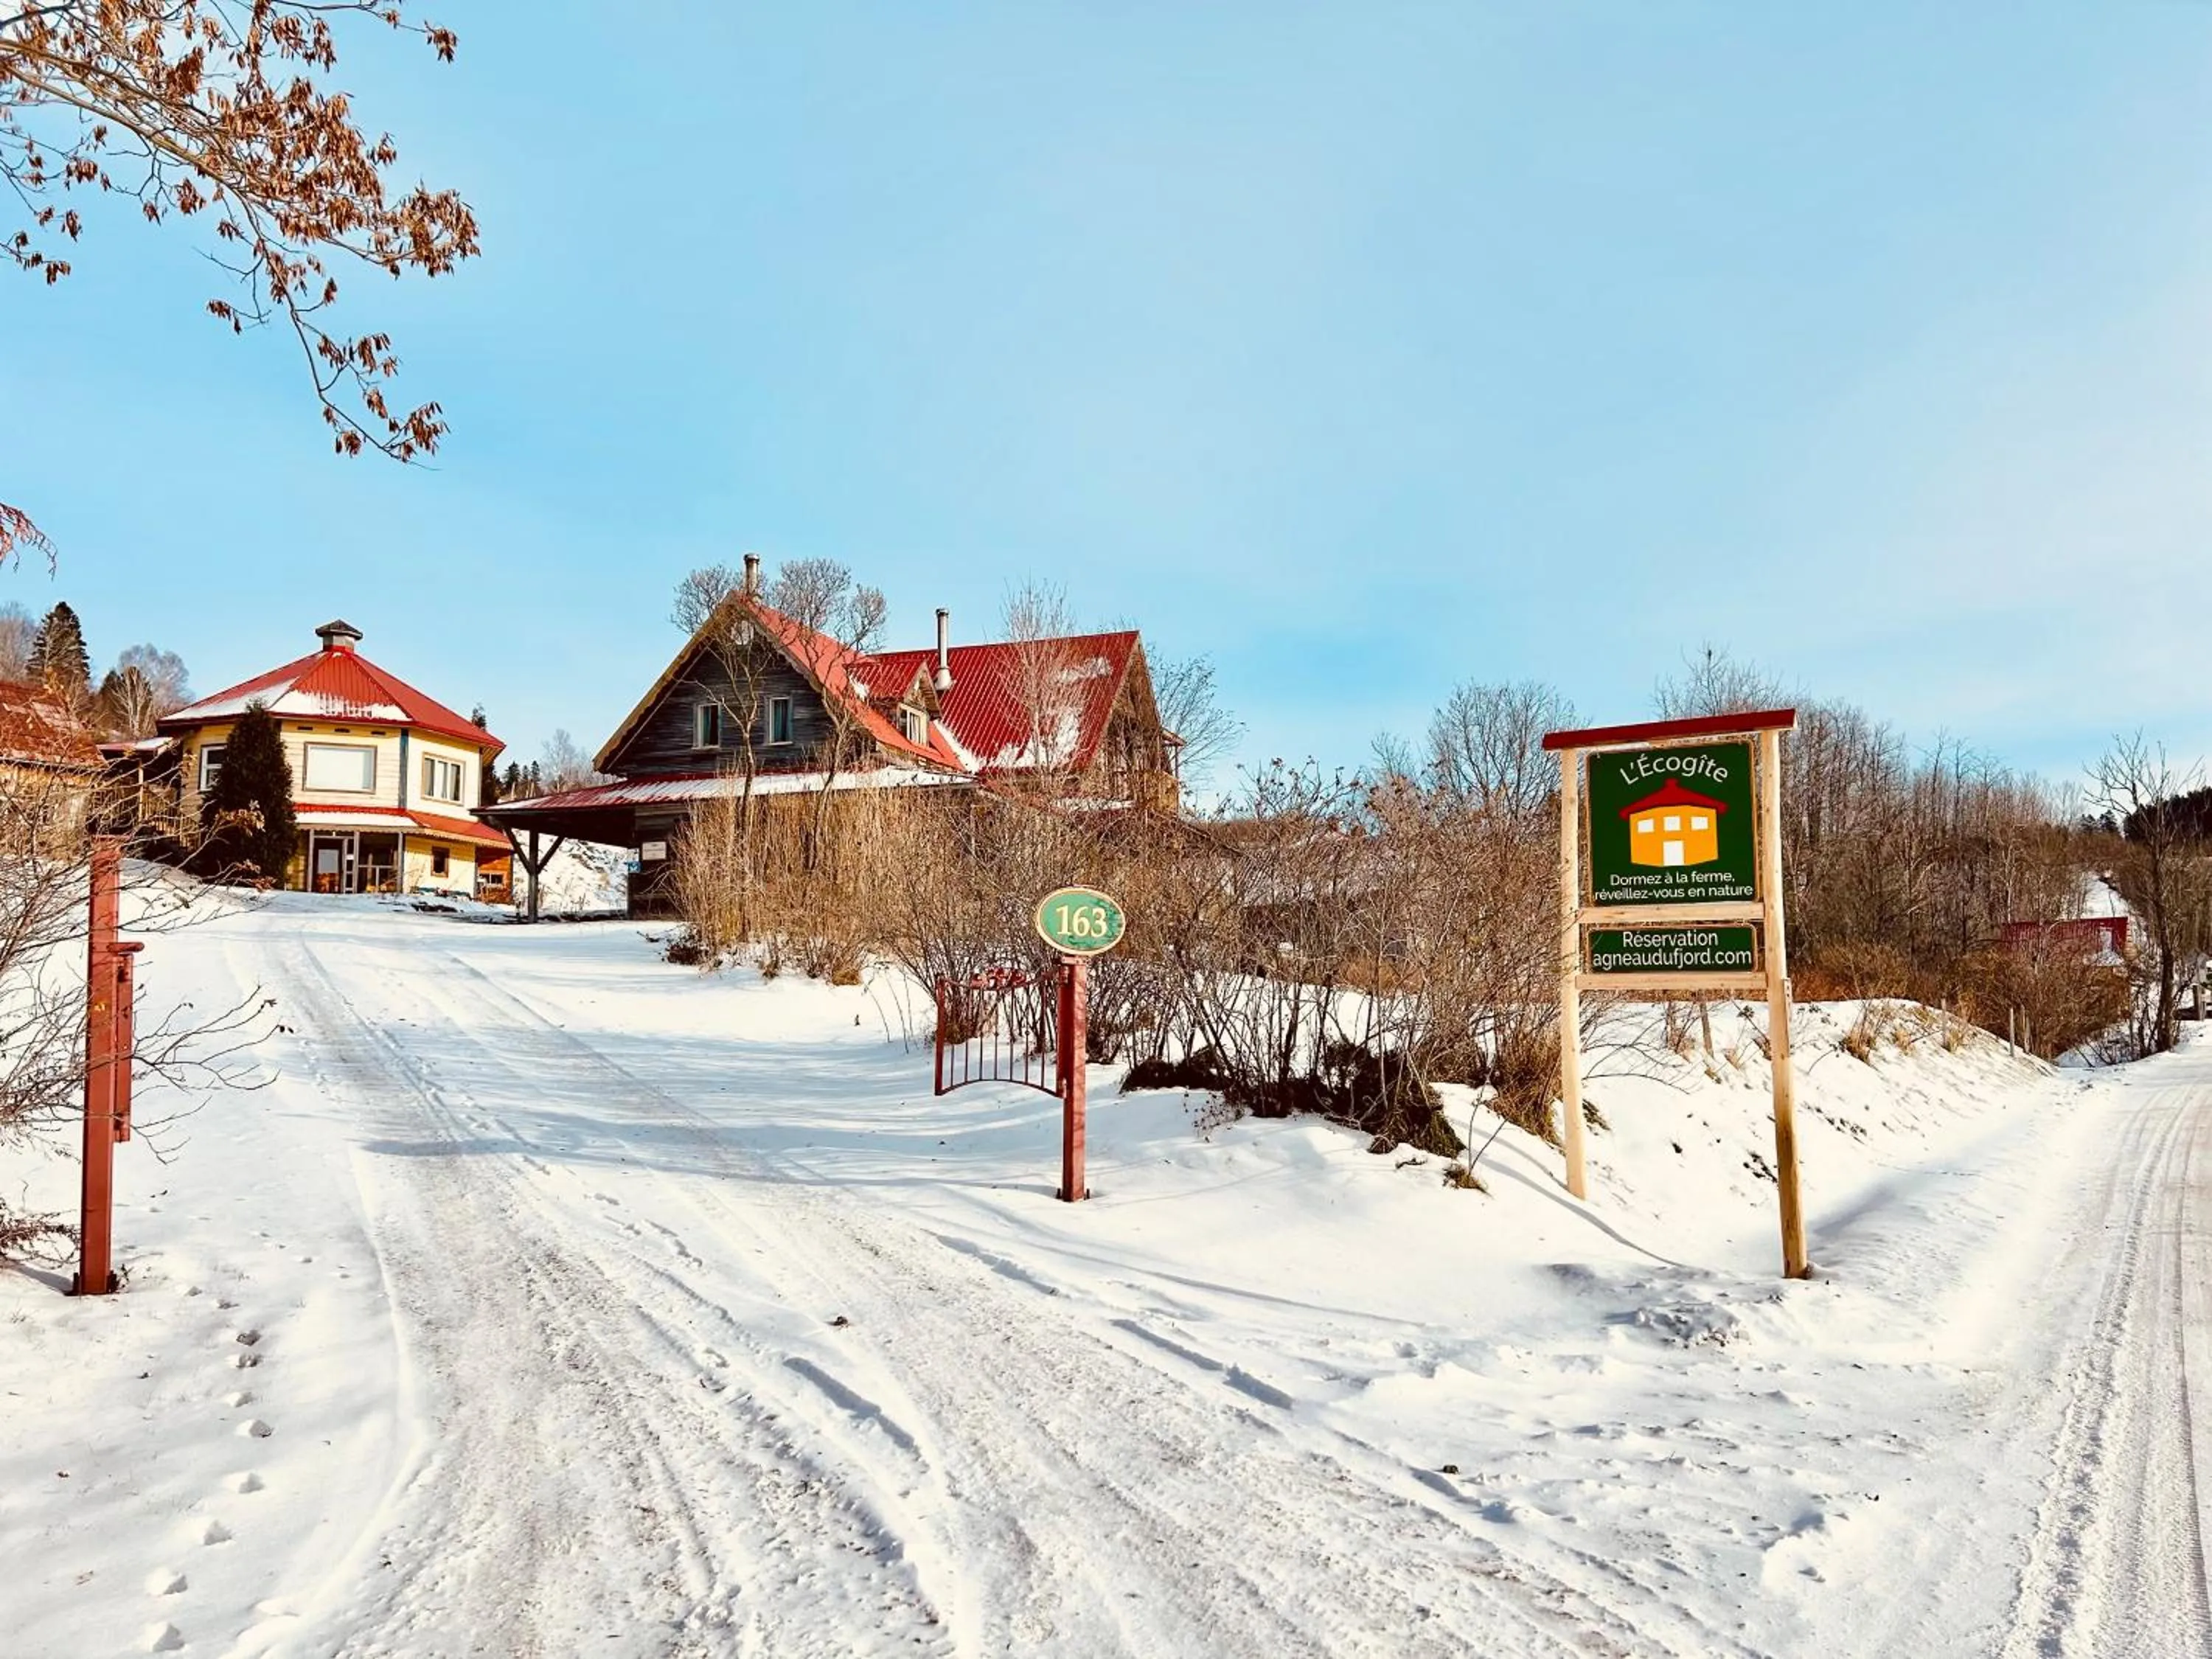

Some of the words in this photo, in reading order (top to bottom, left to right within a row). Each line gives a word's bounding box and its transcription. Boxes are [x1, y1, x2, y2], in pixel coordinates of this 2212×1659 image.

[1620, 754, 1728, 785] L'Écogîte
[1610, 874, 1661, 886] Dormez
[1664, 872, 1673, 883] à
[1676, 872, 1688, 883] la
[1595, 887, 1685, 900] réveillez-vous
[1688, 887, 1705, 897] en
[1708, 885, 1753, 896] nature
[1056, 905, 1107, 937] 163
[1623, 930, 1718, 947] Réservation
[1593, 948, 1752, 970] agneaudufjord.com
